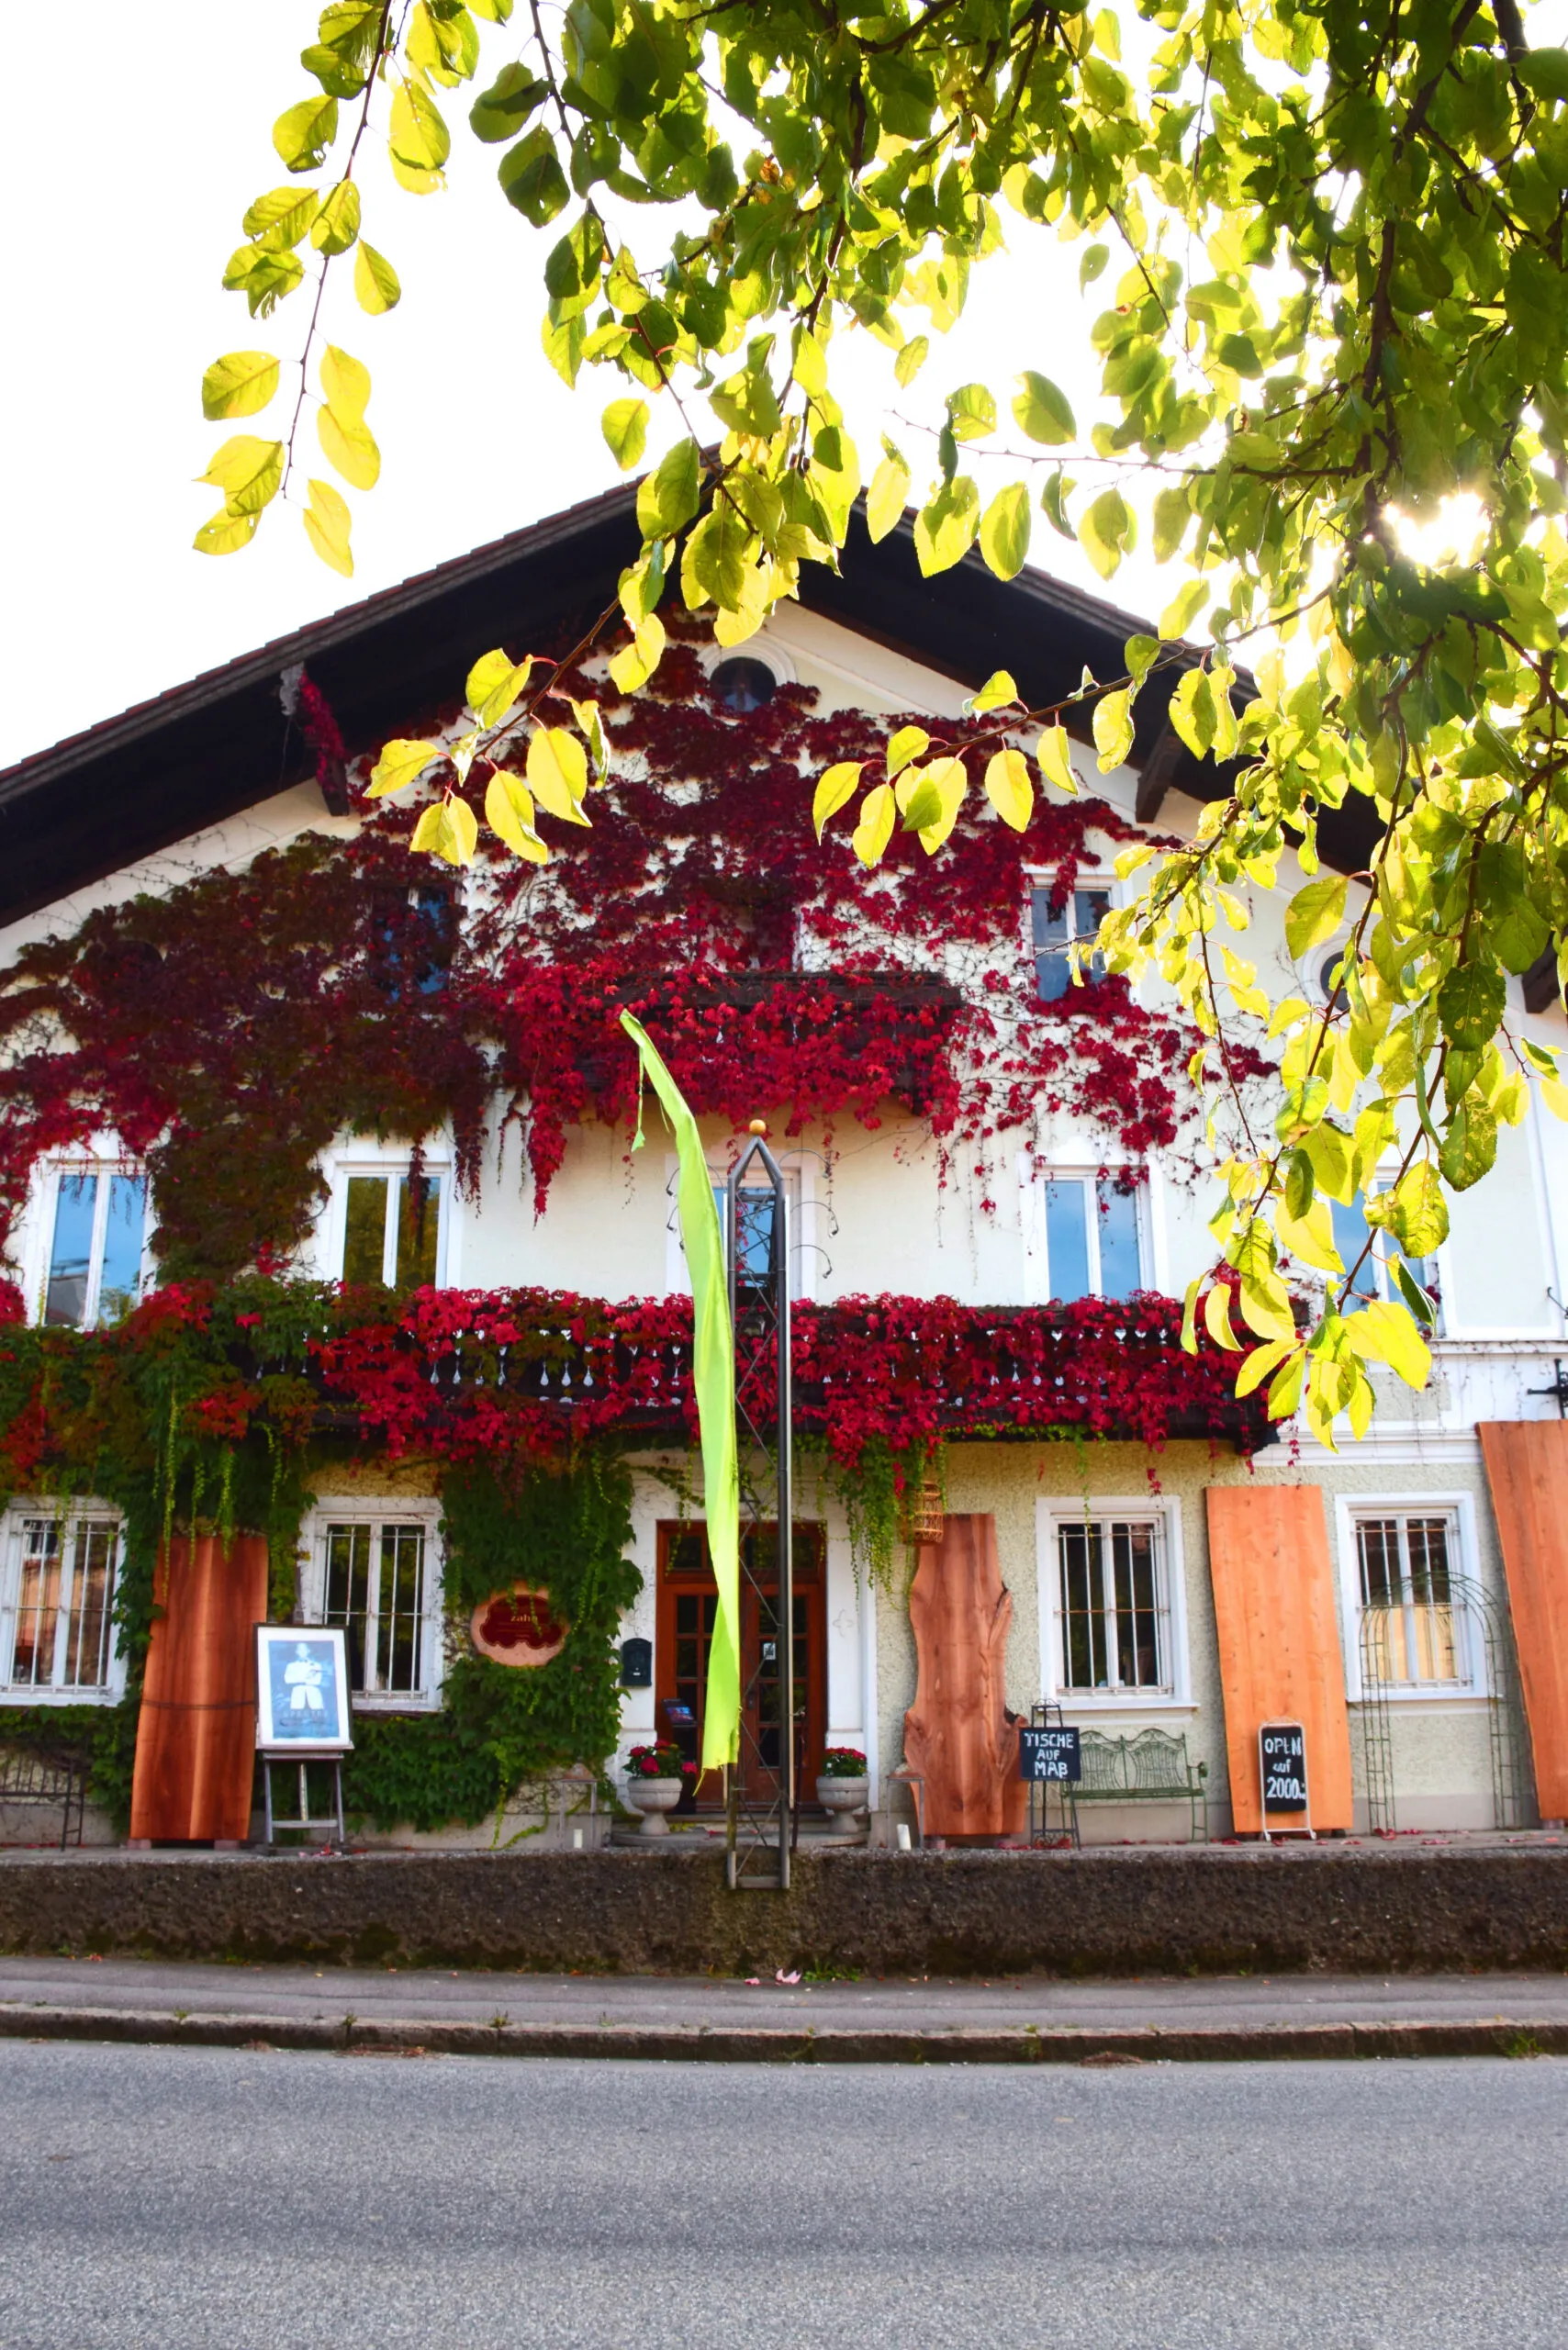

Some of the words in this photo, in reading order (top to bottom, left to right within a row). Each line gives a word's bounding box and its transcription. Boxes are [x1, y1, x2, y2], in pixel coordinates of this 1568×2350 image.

[1024, 1732, 1074, 1749] TISCHE
[1264, 1736, 1302, 1755] OPEN
[1036, 1749, 1060, 1761] AUF
[1272, 1758, 1292, 1773] auf
